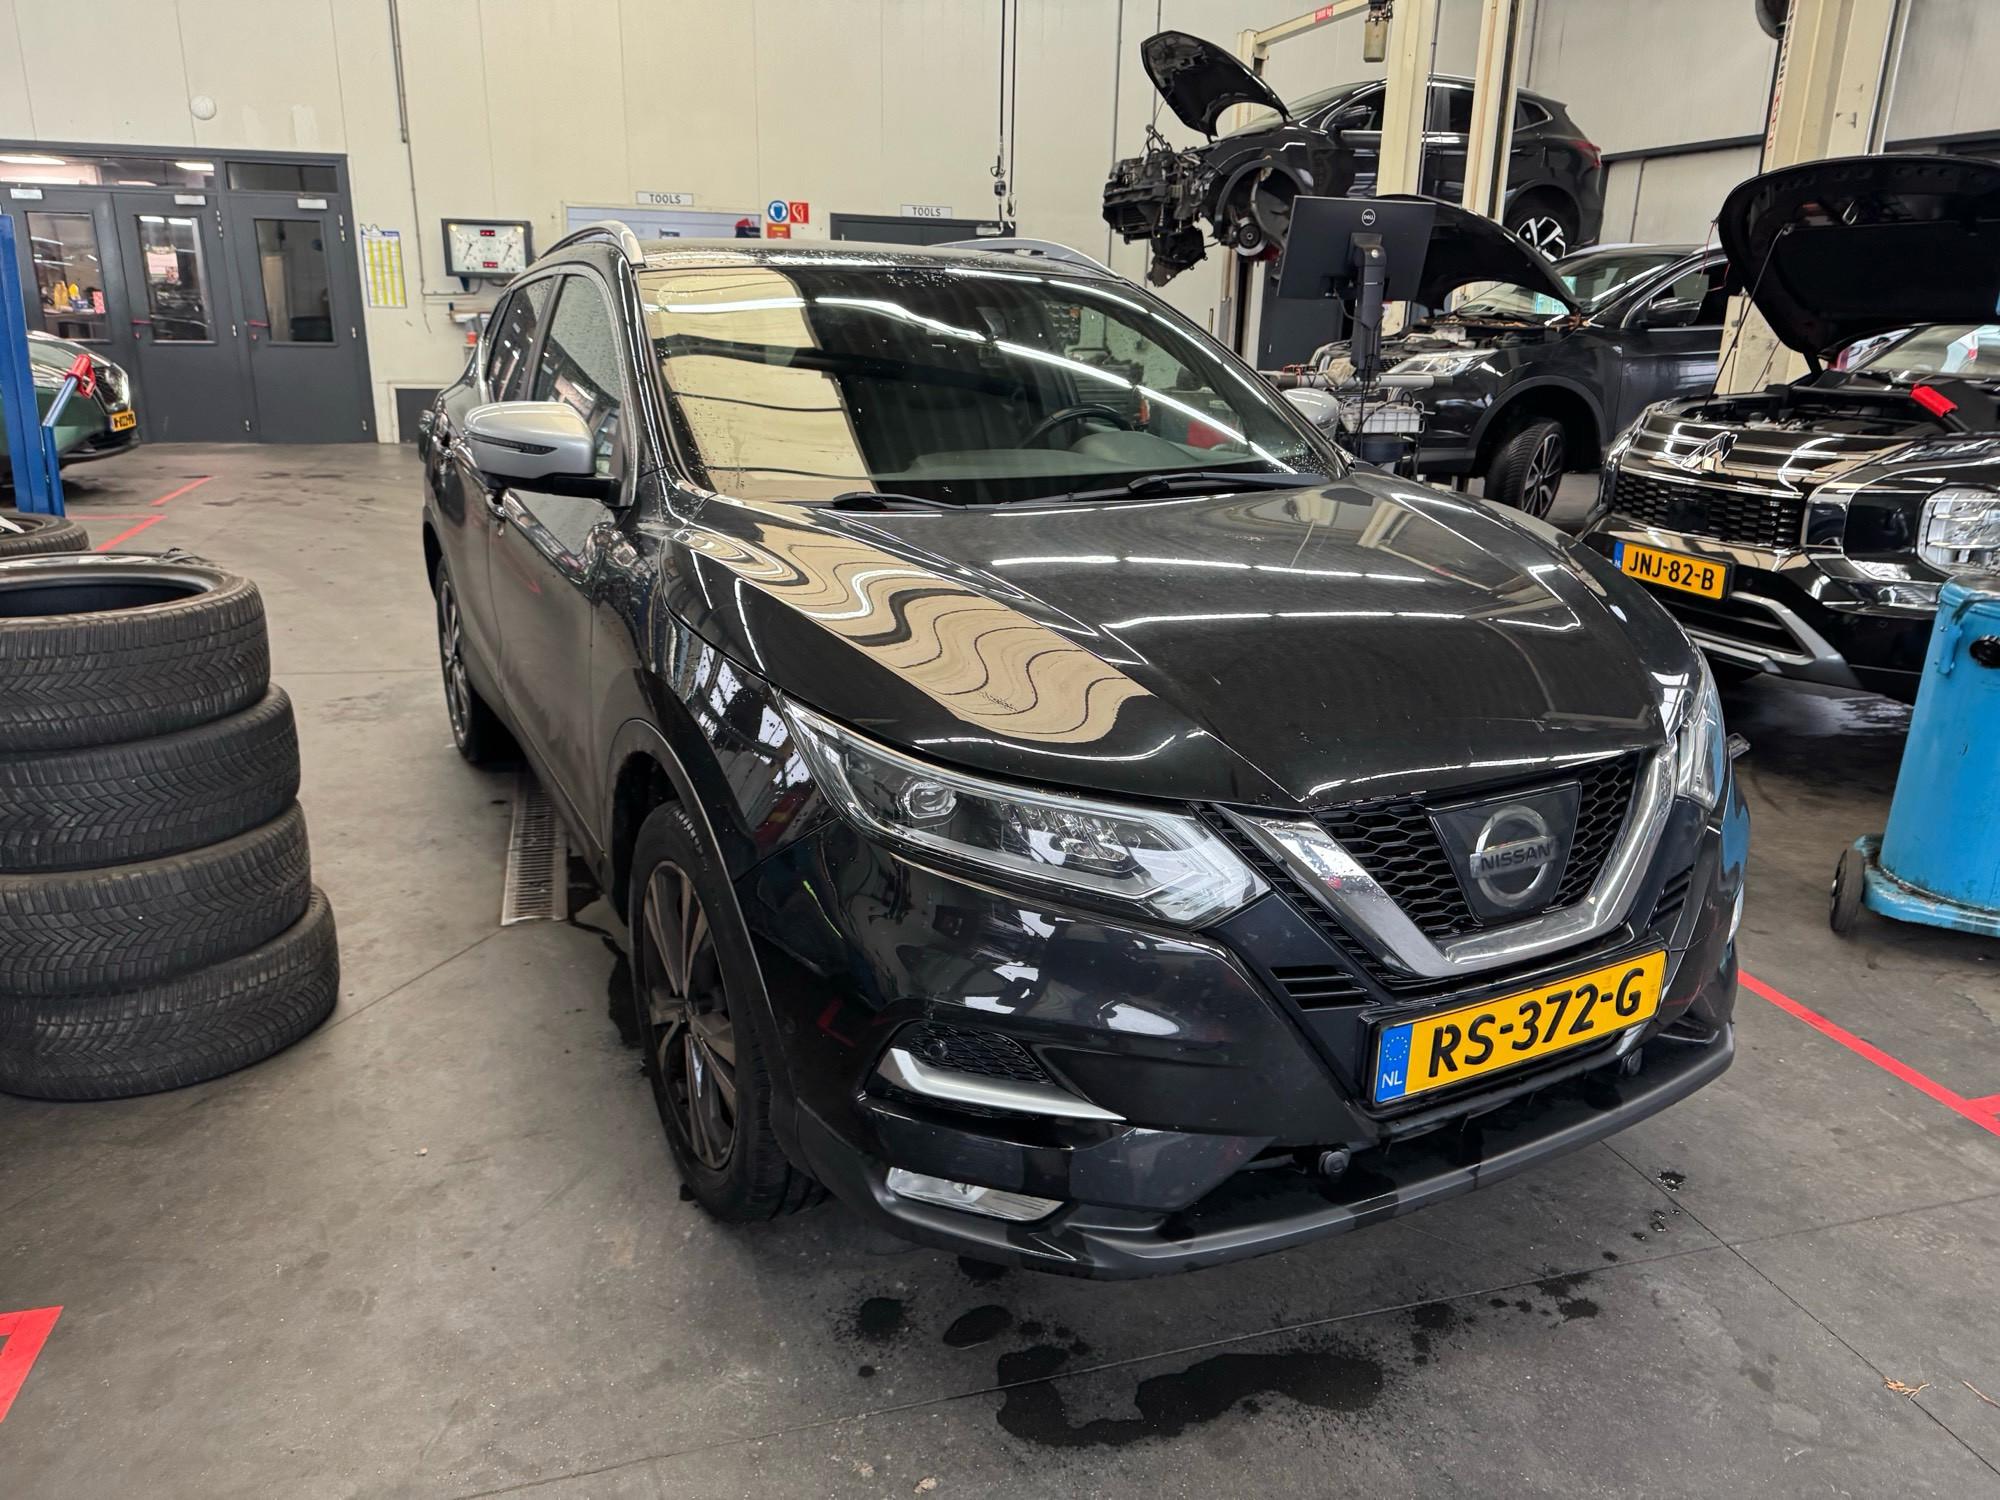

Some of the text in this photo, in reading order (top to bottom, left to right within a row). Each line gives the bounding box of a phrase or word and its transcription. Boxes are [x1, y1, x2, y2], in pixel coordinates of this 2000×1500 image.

[649, 193, 682, 205] TOOLS
[912, 206, 942, 217] TOOLS
[1629, 551, 1715, 591] JNJ-82-B
[1480, 842, 1552, 872] NISSAN
[1428, 967, 1645, 1078] RS-372-G
[1381, 1071, 1403, 1089] NL
